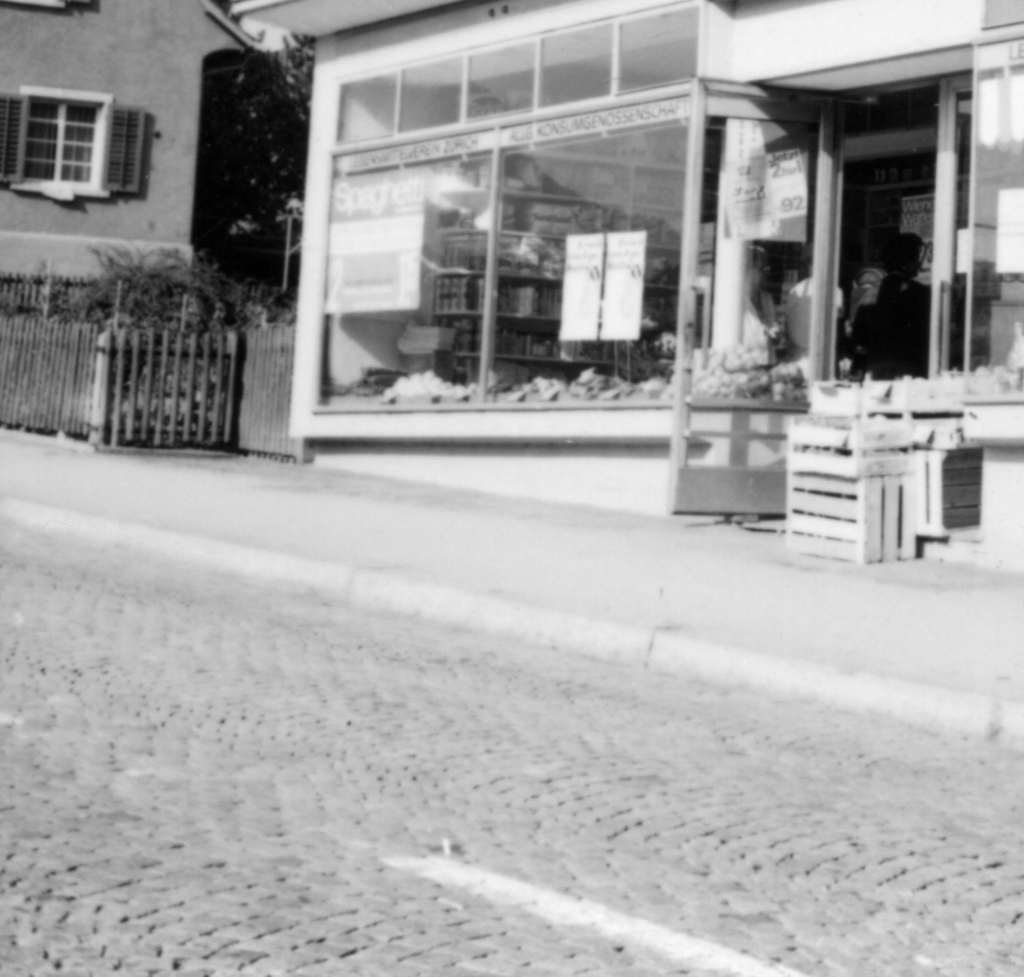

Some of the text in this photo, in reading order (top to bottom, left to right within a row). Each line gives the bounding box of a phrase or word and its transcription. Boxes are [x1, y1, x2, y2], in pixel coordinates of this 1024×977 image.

[509, 100, 690, 142] ALLG KONSUMGENOSSENSCHAFT
[335, 176, 424, 217] Spaghetti
